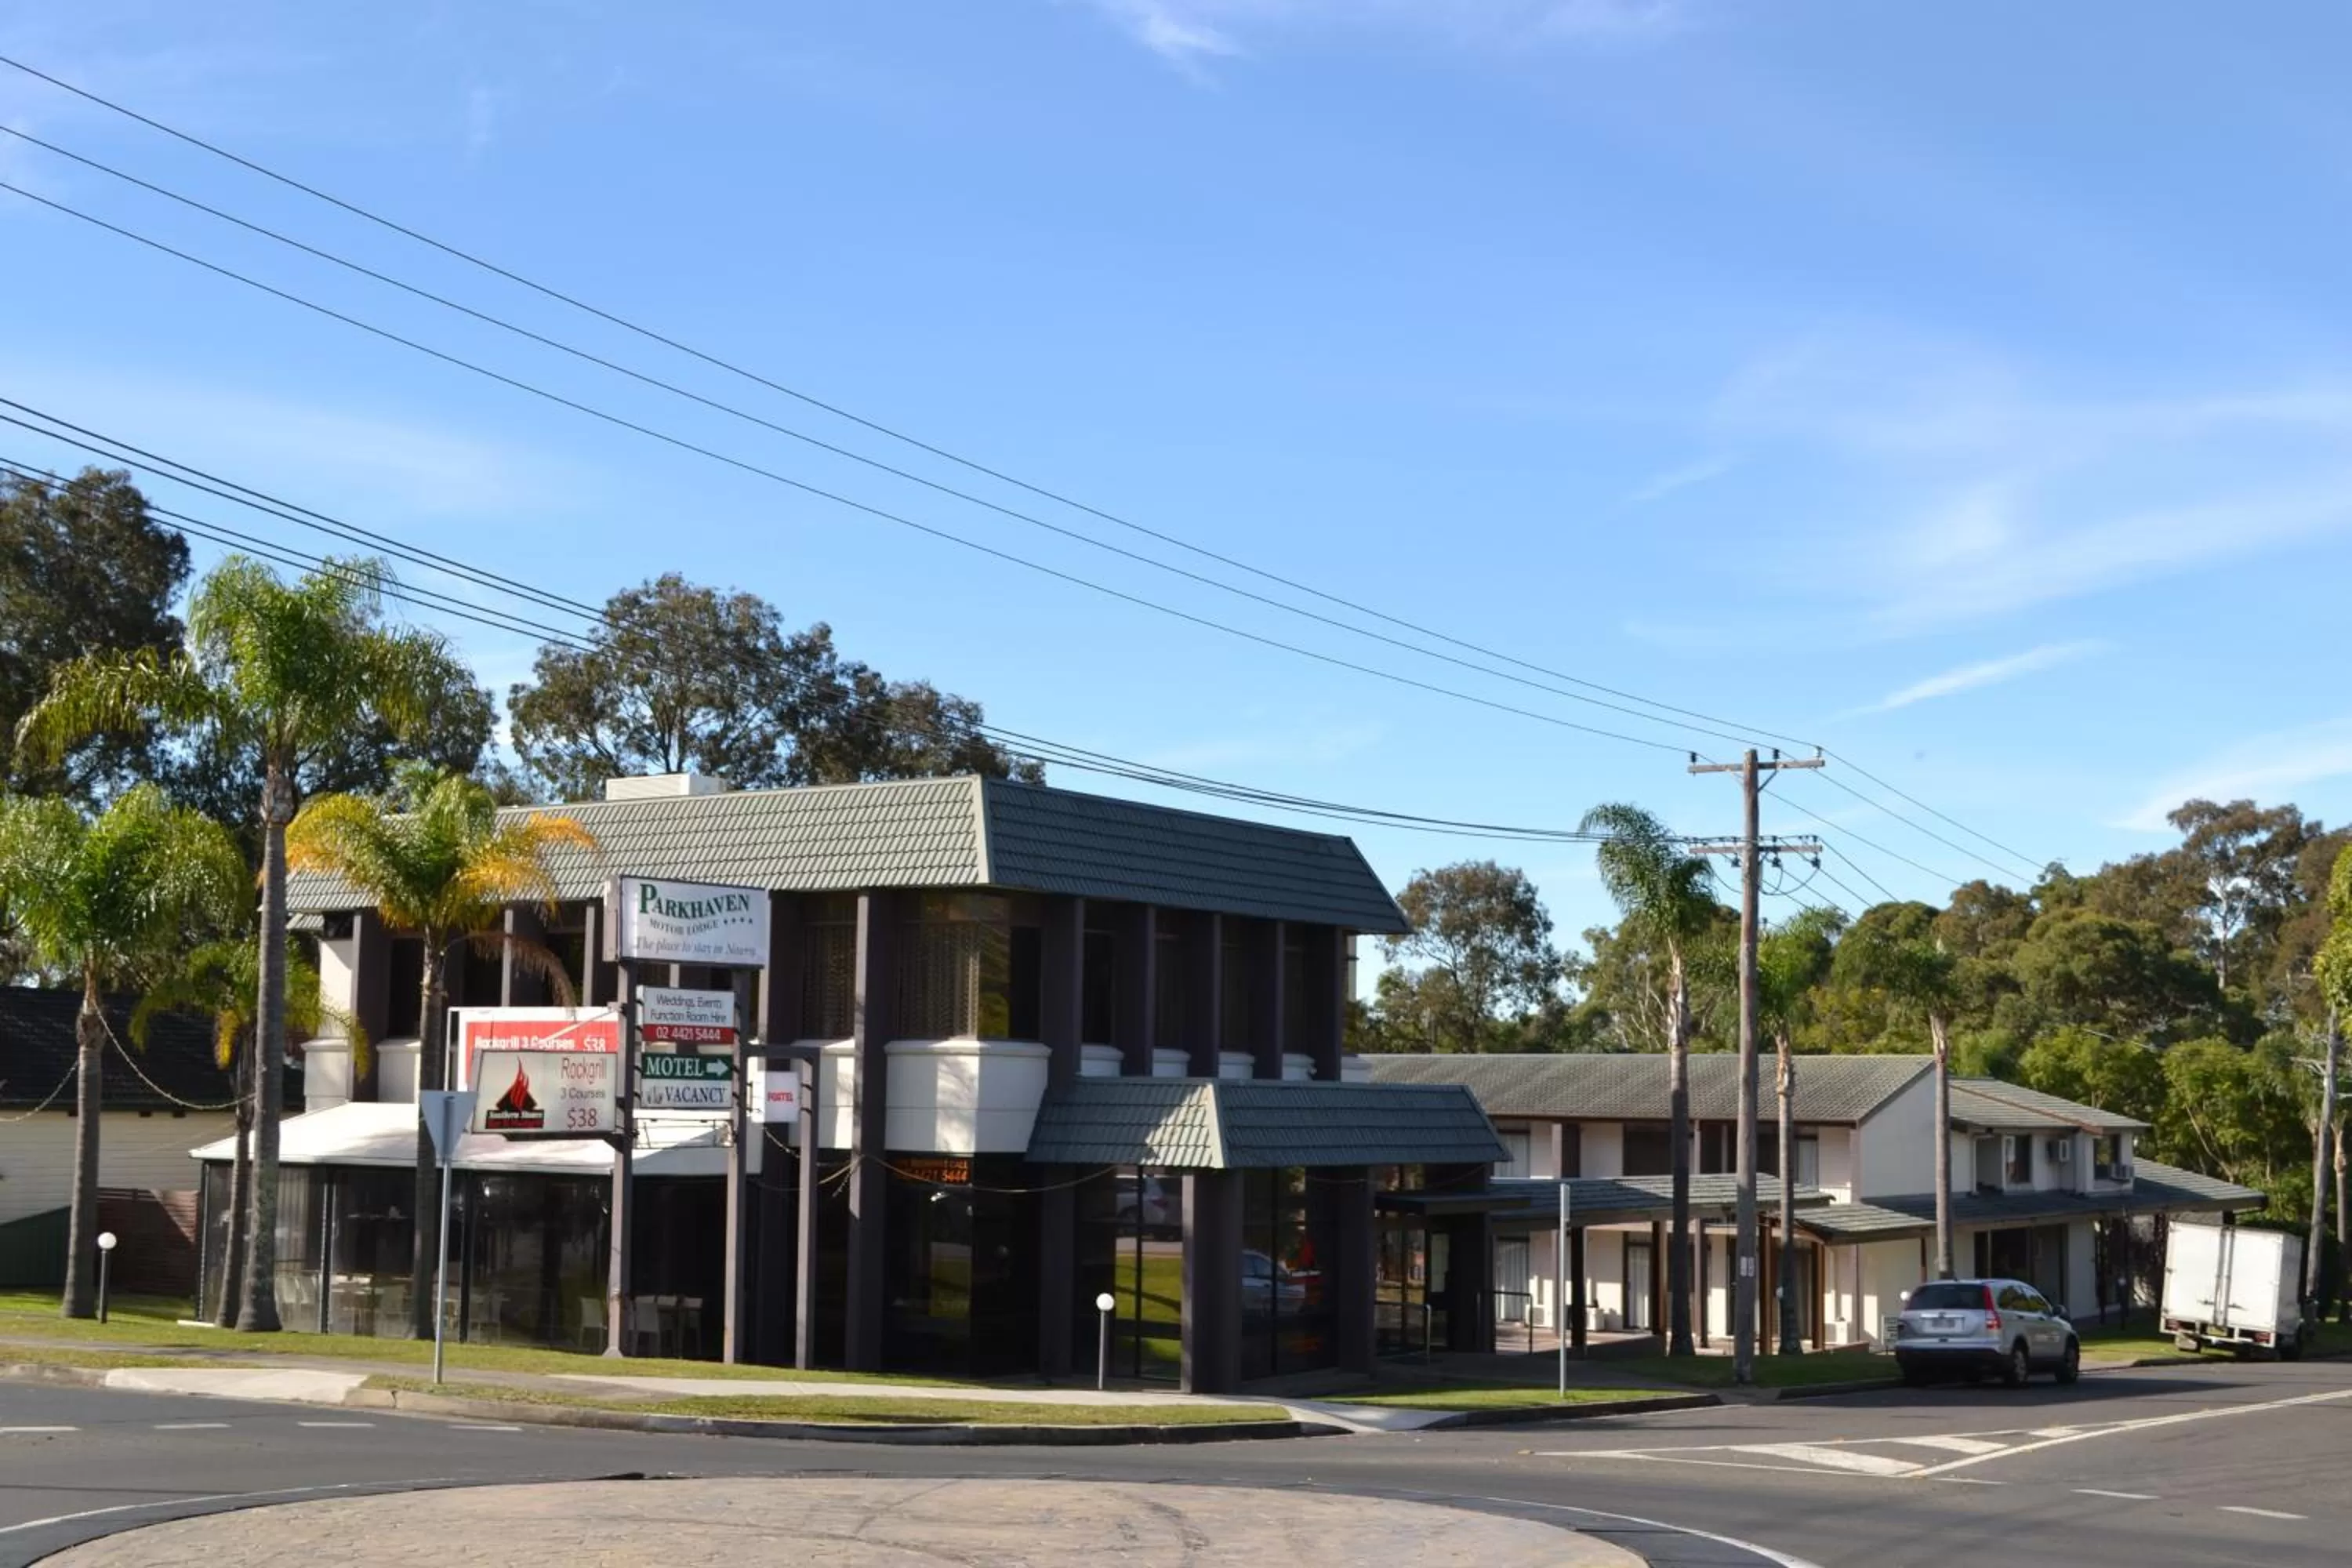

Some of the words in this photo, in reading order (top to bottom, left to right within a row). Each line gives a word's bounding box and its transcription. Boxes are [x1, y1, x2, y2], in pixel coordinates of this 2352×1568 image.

[640, 883, 750, 920] PARKHAVEN
[655, 1026, 669, 1040] 02
[671, 1027, 694, 1040] 4421
[695, 1028, 721, 1041] 5444
[561, 1056, 607, 1085] Rockgrill
[646, 1056, 704, 1077] MOTEL
[561, 1088, 567, 1099] 3
[568, 1087, 606, 1100] Courses
[664, 1086, 726, 1104] VACANCY
[567, 1107, 598, 1129] $38
